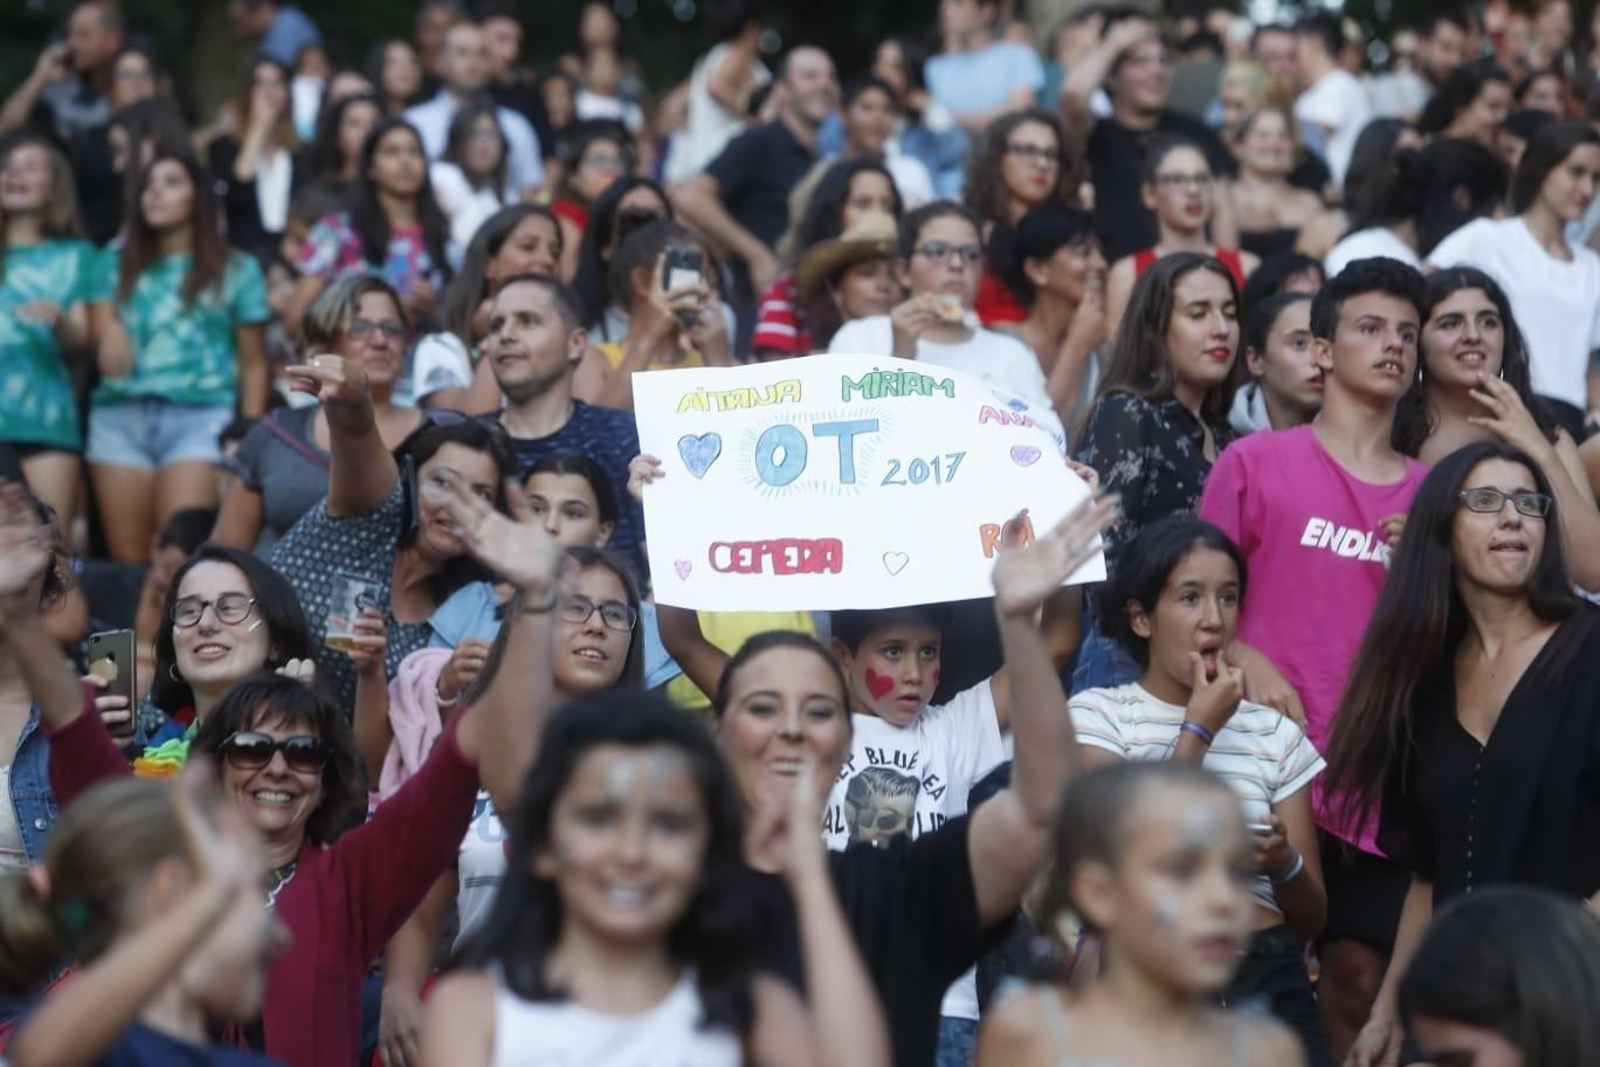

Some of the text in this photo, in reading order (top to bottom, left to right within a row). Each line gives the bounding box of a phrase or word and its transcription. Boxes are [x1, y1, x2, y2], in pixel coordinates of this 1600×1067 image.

[676, 379, 802, 413] AITANA
[841, 367, 956, 402] MIRIAM
[754, 418, 968, 487] OT 2017
[708, 537, 844, 575] CEPEDA
[864, 746, 920, 771] BLUE
